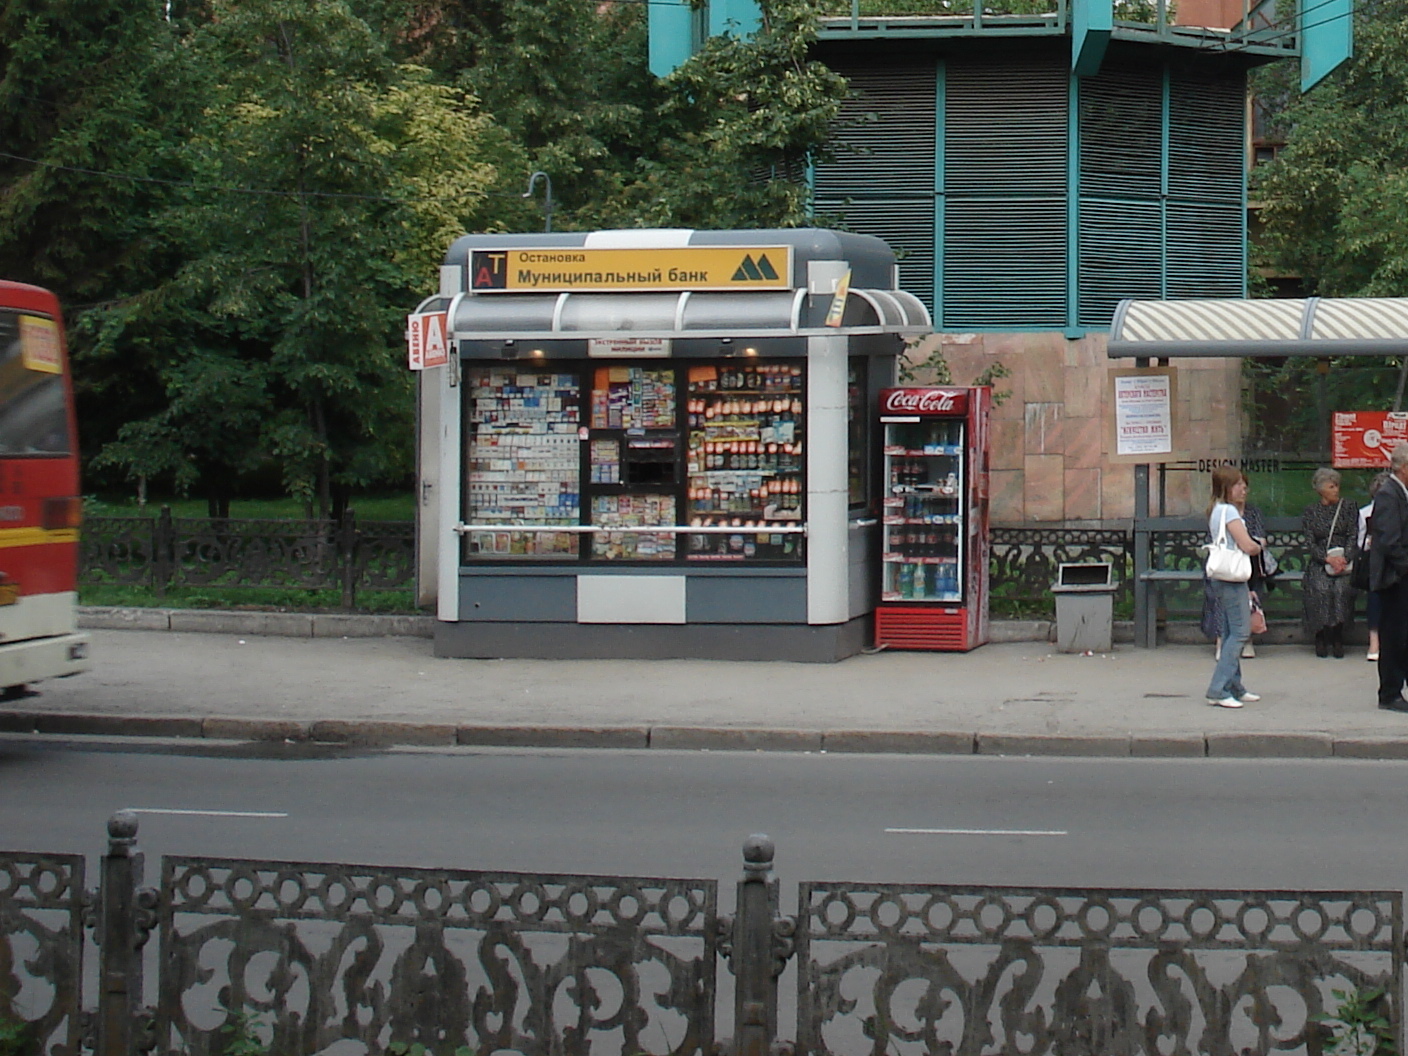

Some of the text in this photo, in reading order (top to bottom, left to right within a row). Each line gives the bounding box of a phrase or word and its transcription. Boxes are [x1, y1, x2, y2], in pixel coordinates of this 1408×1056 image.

[519, 252, 586, 263] Остановка
[518, 267, 708, 287] Муниципальный банк
[411, 320, 420, 364] АВЕНЮ
[886, 390, 957, 411] Coca-Cola
[1241, 458, 1280, 473] MASTER
